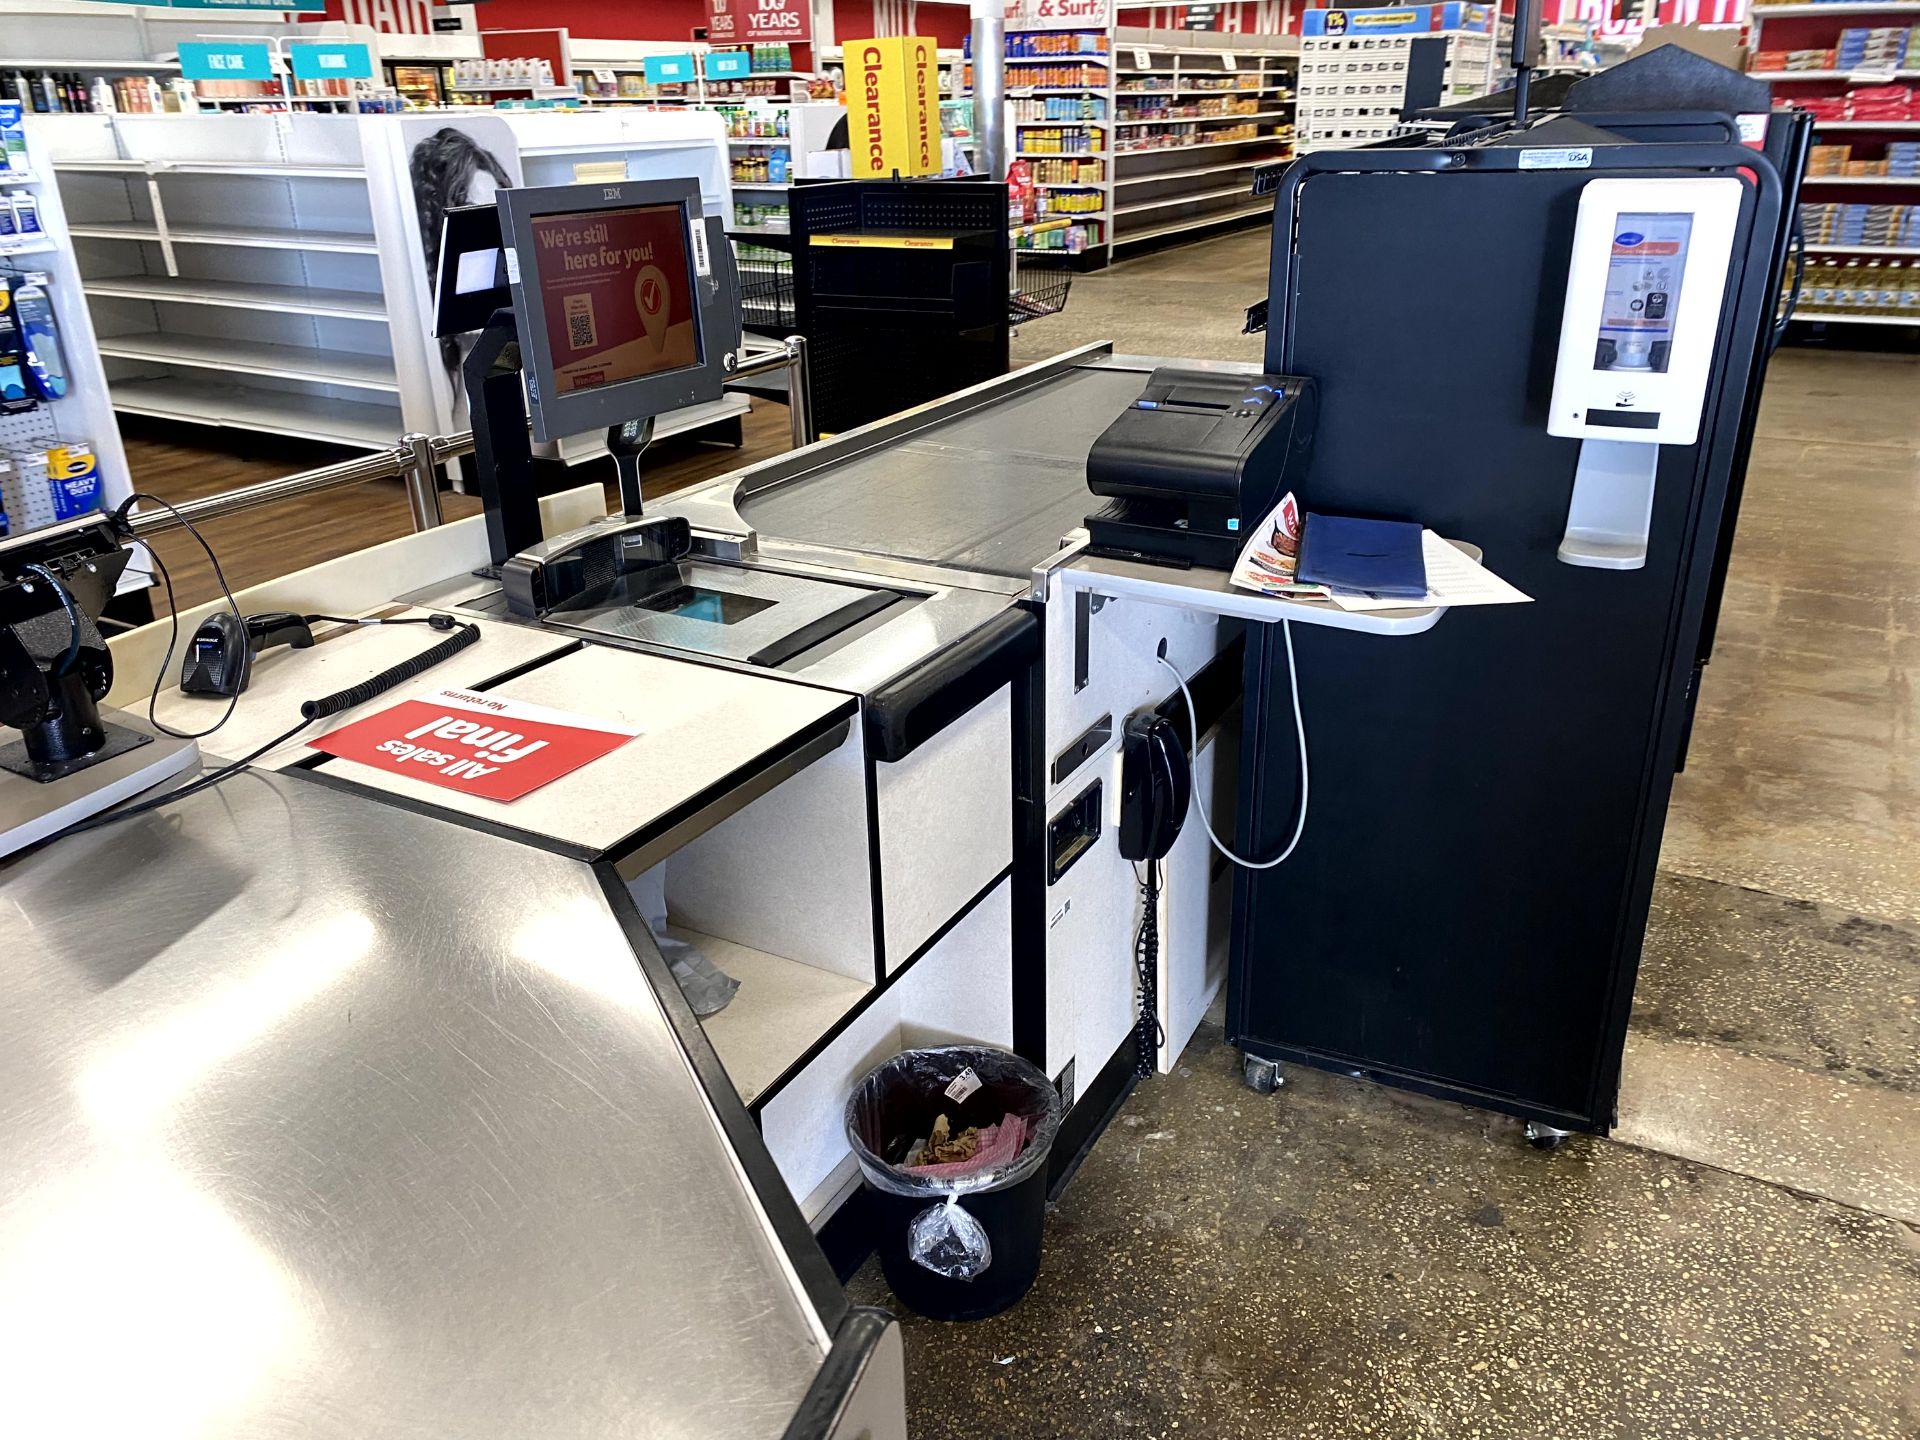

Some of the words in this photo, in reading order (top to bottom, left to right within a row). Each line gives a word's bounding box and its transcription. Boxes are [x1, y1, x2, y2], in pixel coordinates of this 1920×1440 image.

[1038, 0, 1054, 17] &
[748, 12, 800, 28] YEARS
[863, 47, 883, 170] Clearance
[915, 45, 929, 168] Clearance
[604, 189, 621, 200] IBM
[539, 228, 582, 249] We're
[583, 223, 608, 244] still
[563, 250, 598, 271] here
[600, 246, 621, 266] for
[624, 242, 653, 269] you!
[440, 690, 488, 705] returns
[487, 702, 508, 711] No
[375, 739, 456, 766] sales
[439, 759, 501, 779] All
[959, 1068, 973, 1080] 3.49
